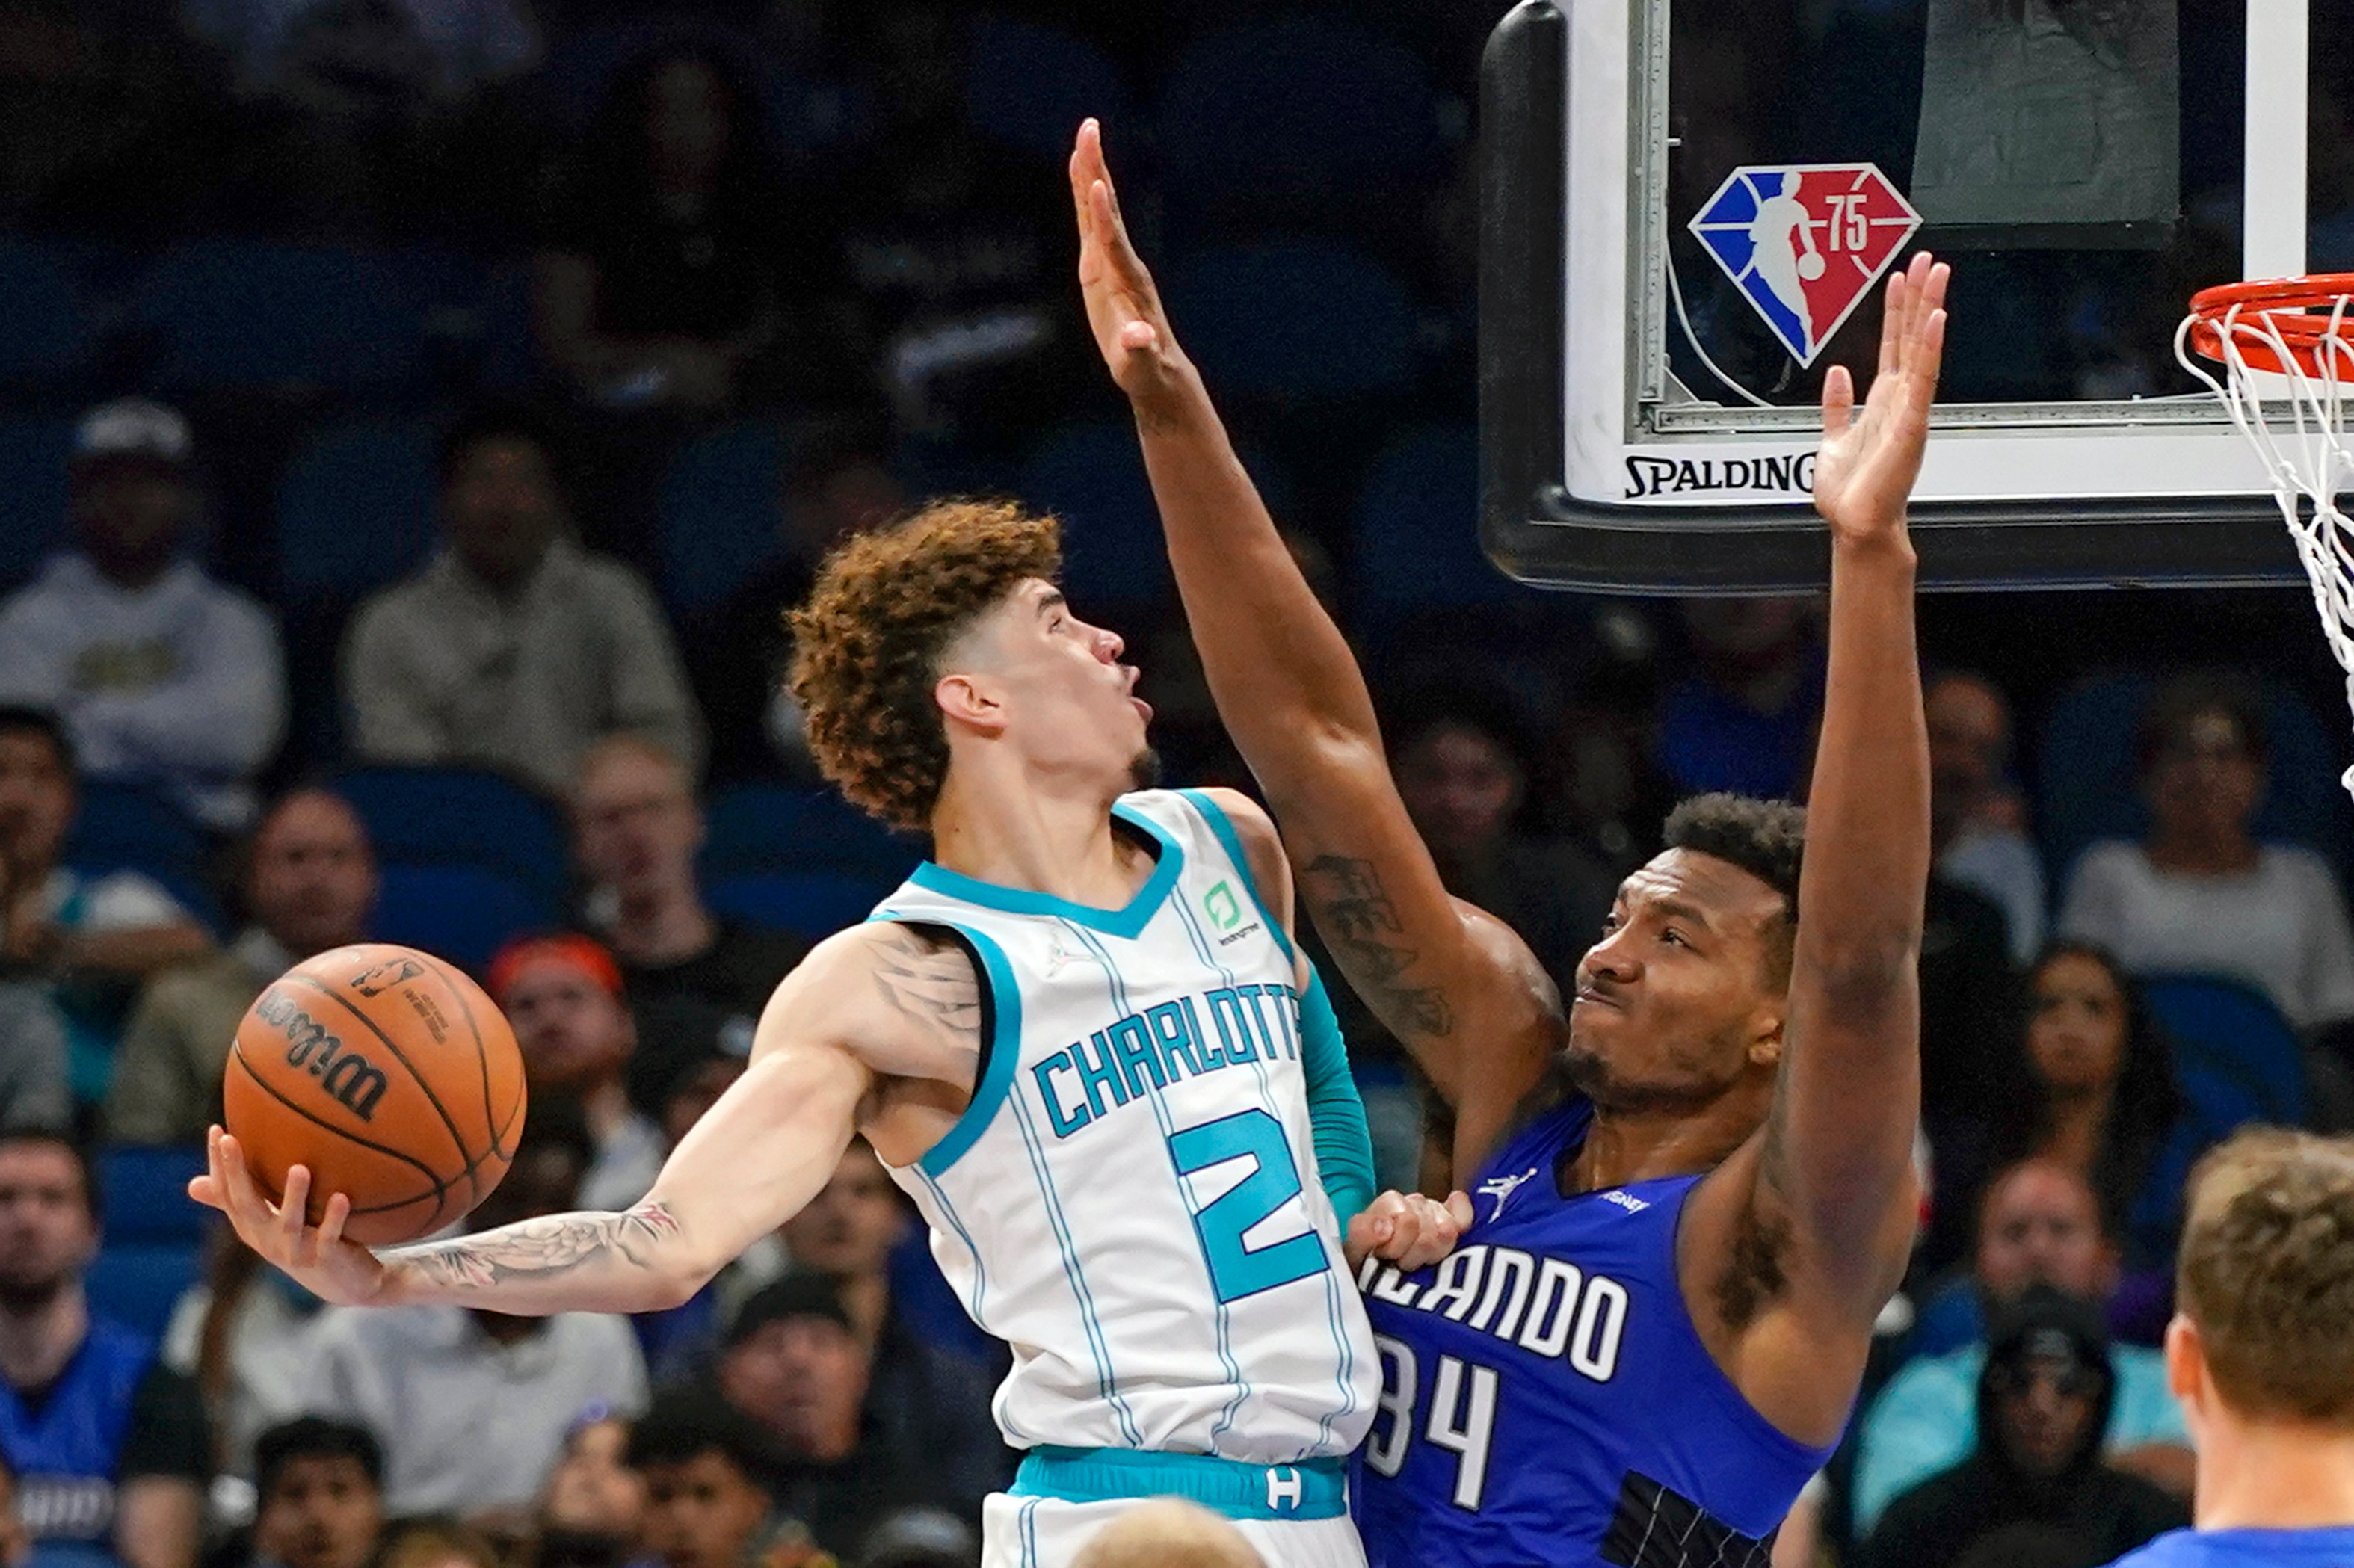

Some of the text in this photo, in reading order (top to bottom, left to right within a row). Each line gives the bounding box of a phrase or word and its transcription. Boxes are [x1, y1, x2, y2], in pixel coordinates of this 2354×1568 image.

[1825, 194, 1867, 252] 75
[1624, 450, 1819, 499] SPALDING
[256, 989, 387, 1123] Wilson
[1168, 1106, 1331, 1306] 2
[1364, 1330, 1499, 1514] 34
[1264, 1466, 1302, 1512] H
